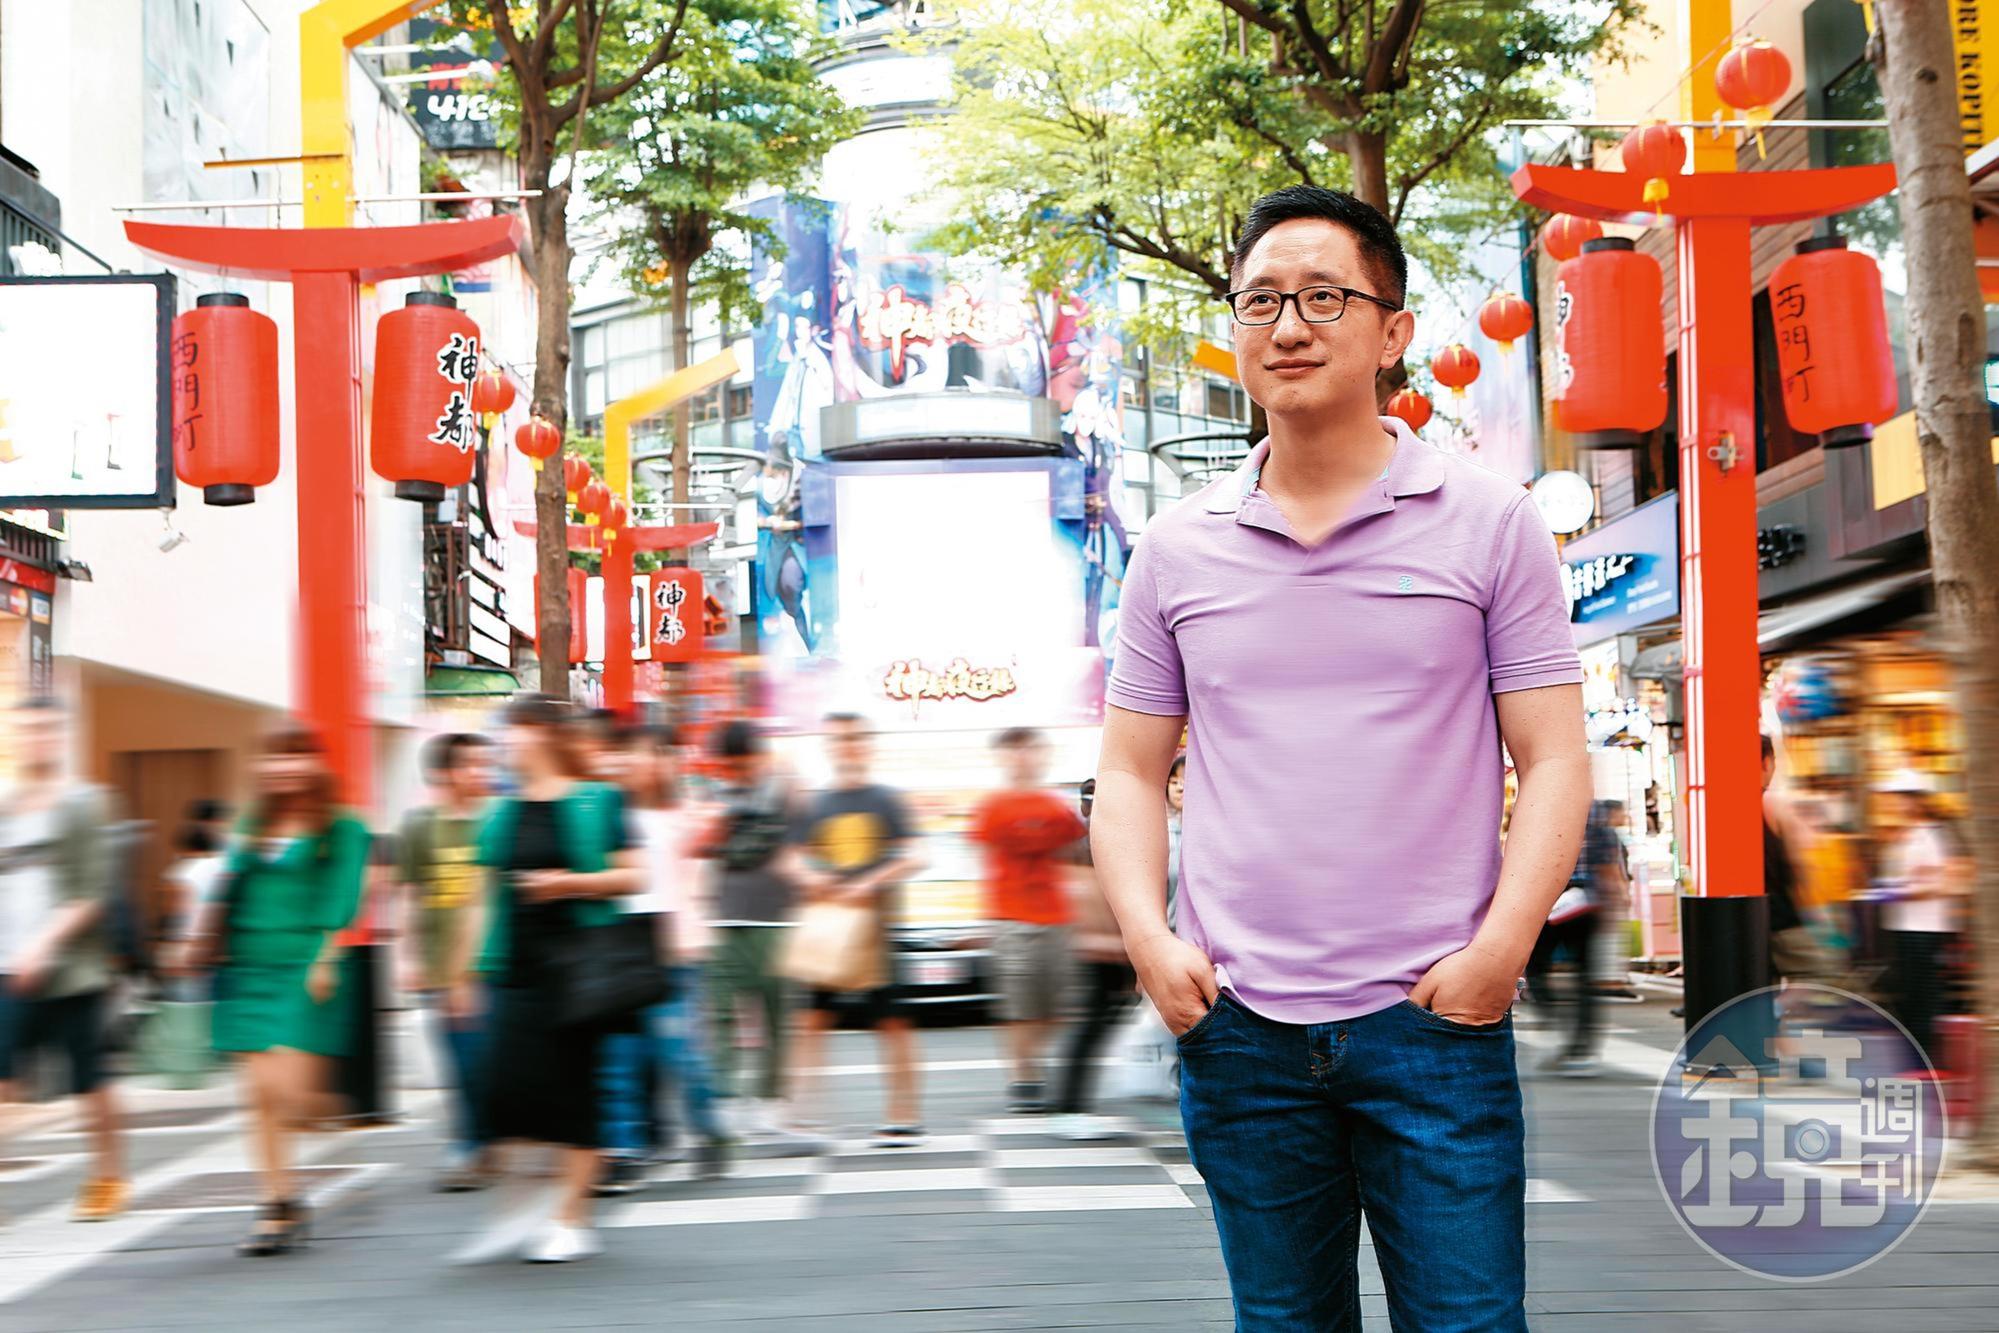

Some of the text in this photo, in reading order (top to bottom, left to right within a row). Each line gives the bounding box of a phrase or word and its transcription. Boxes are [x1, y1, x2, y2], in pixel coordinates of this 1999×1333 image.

[1957, 0, 1979, 43] RE
[427, 332, 479, 454] 神都
[654, 579, 687, 645] 神都
